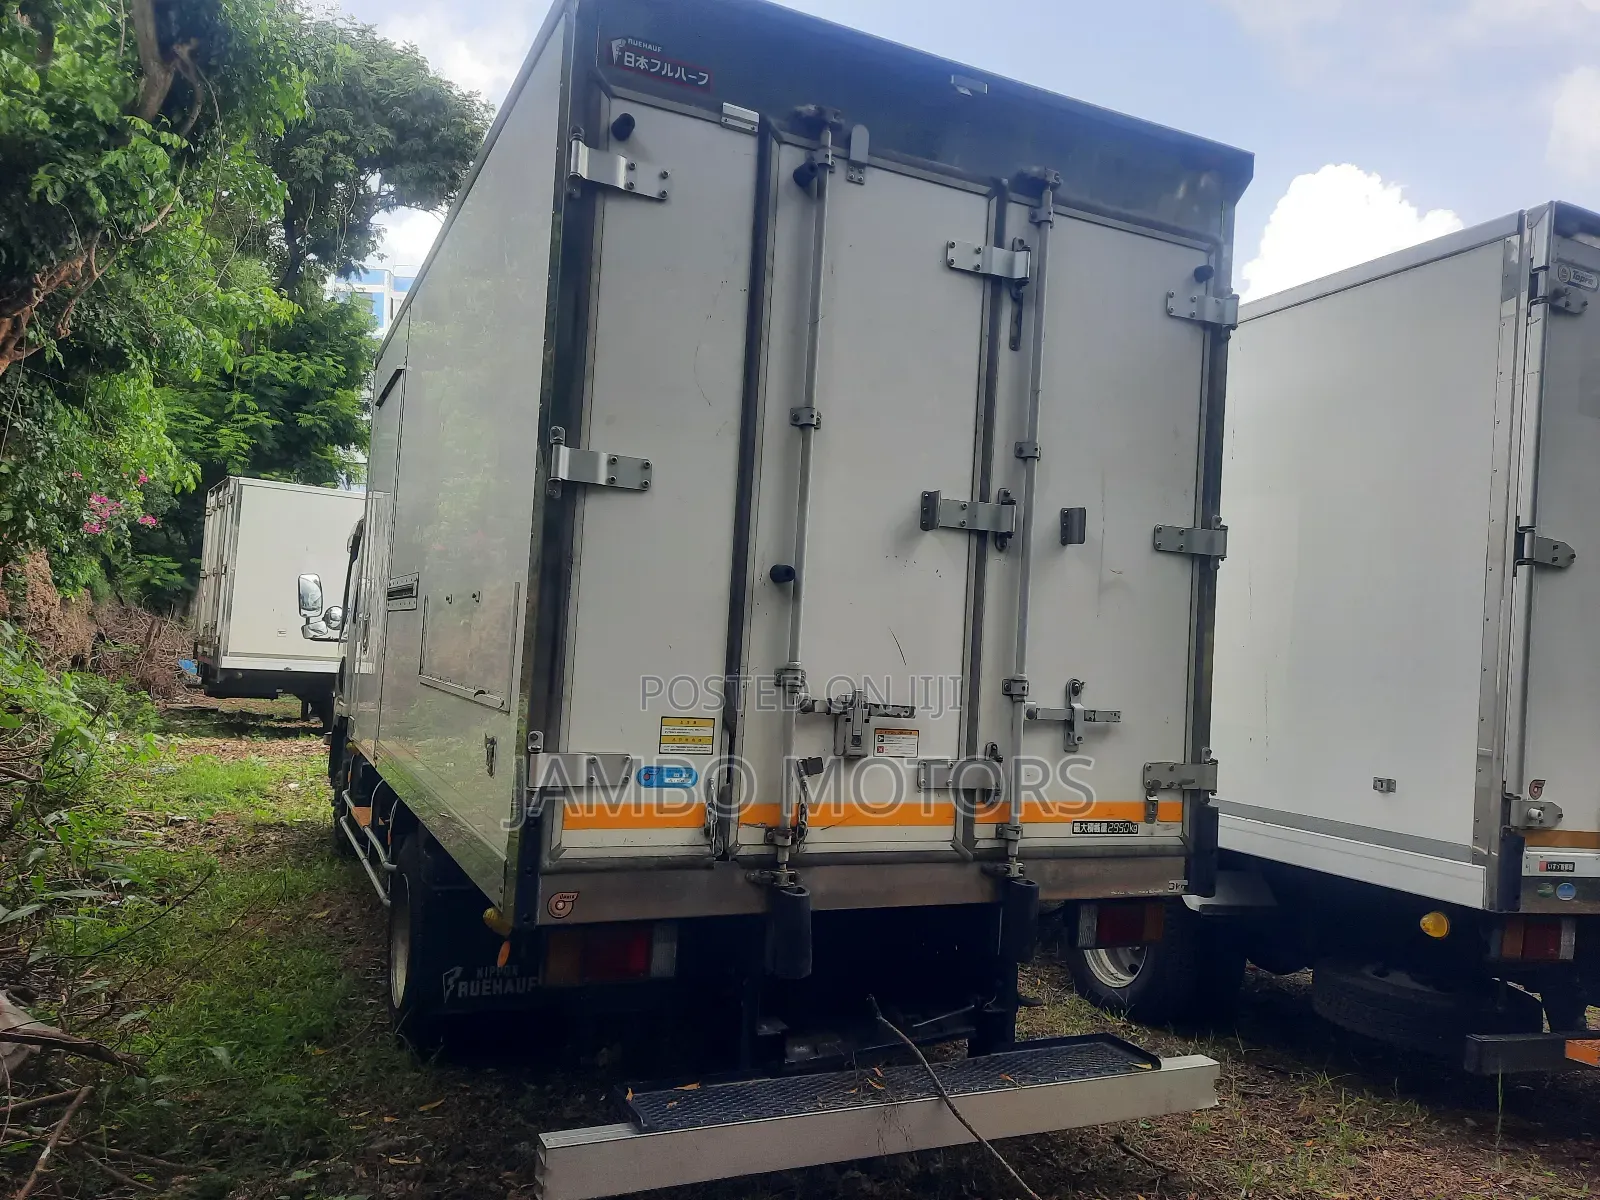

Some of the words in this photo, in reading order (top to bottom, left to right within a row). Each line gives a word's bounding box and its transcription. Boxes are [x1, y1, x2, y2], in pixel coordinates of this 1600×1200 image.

[624, 51, 709, 84] 日本フルハーフ
